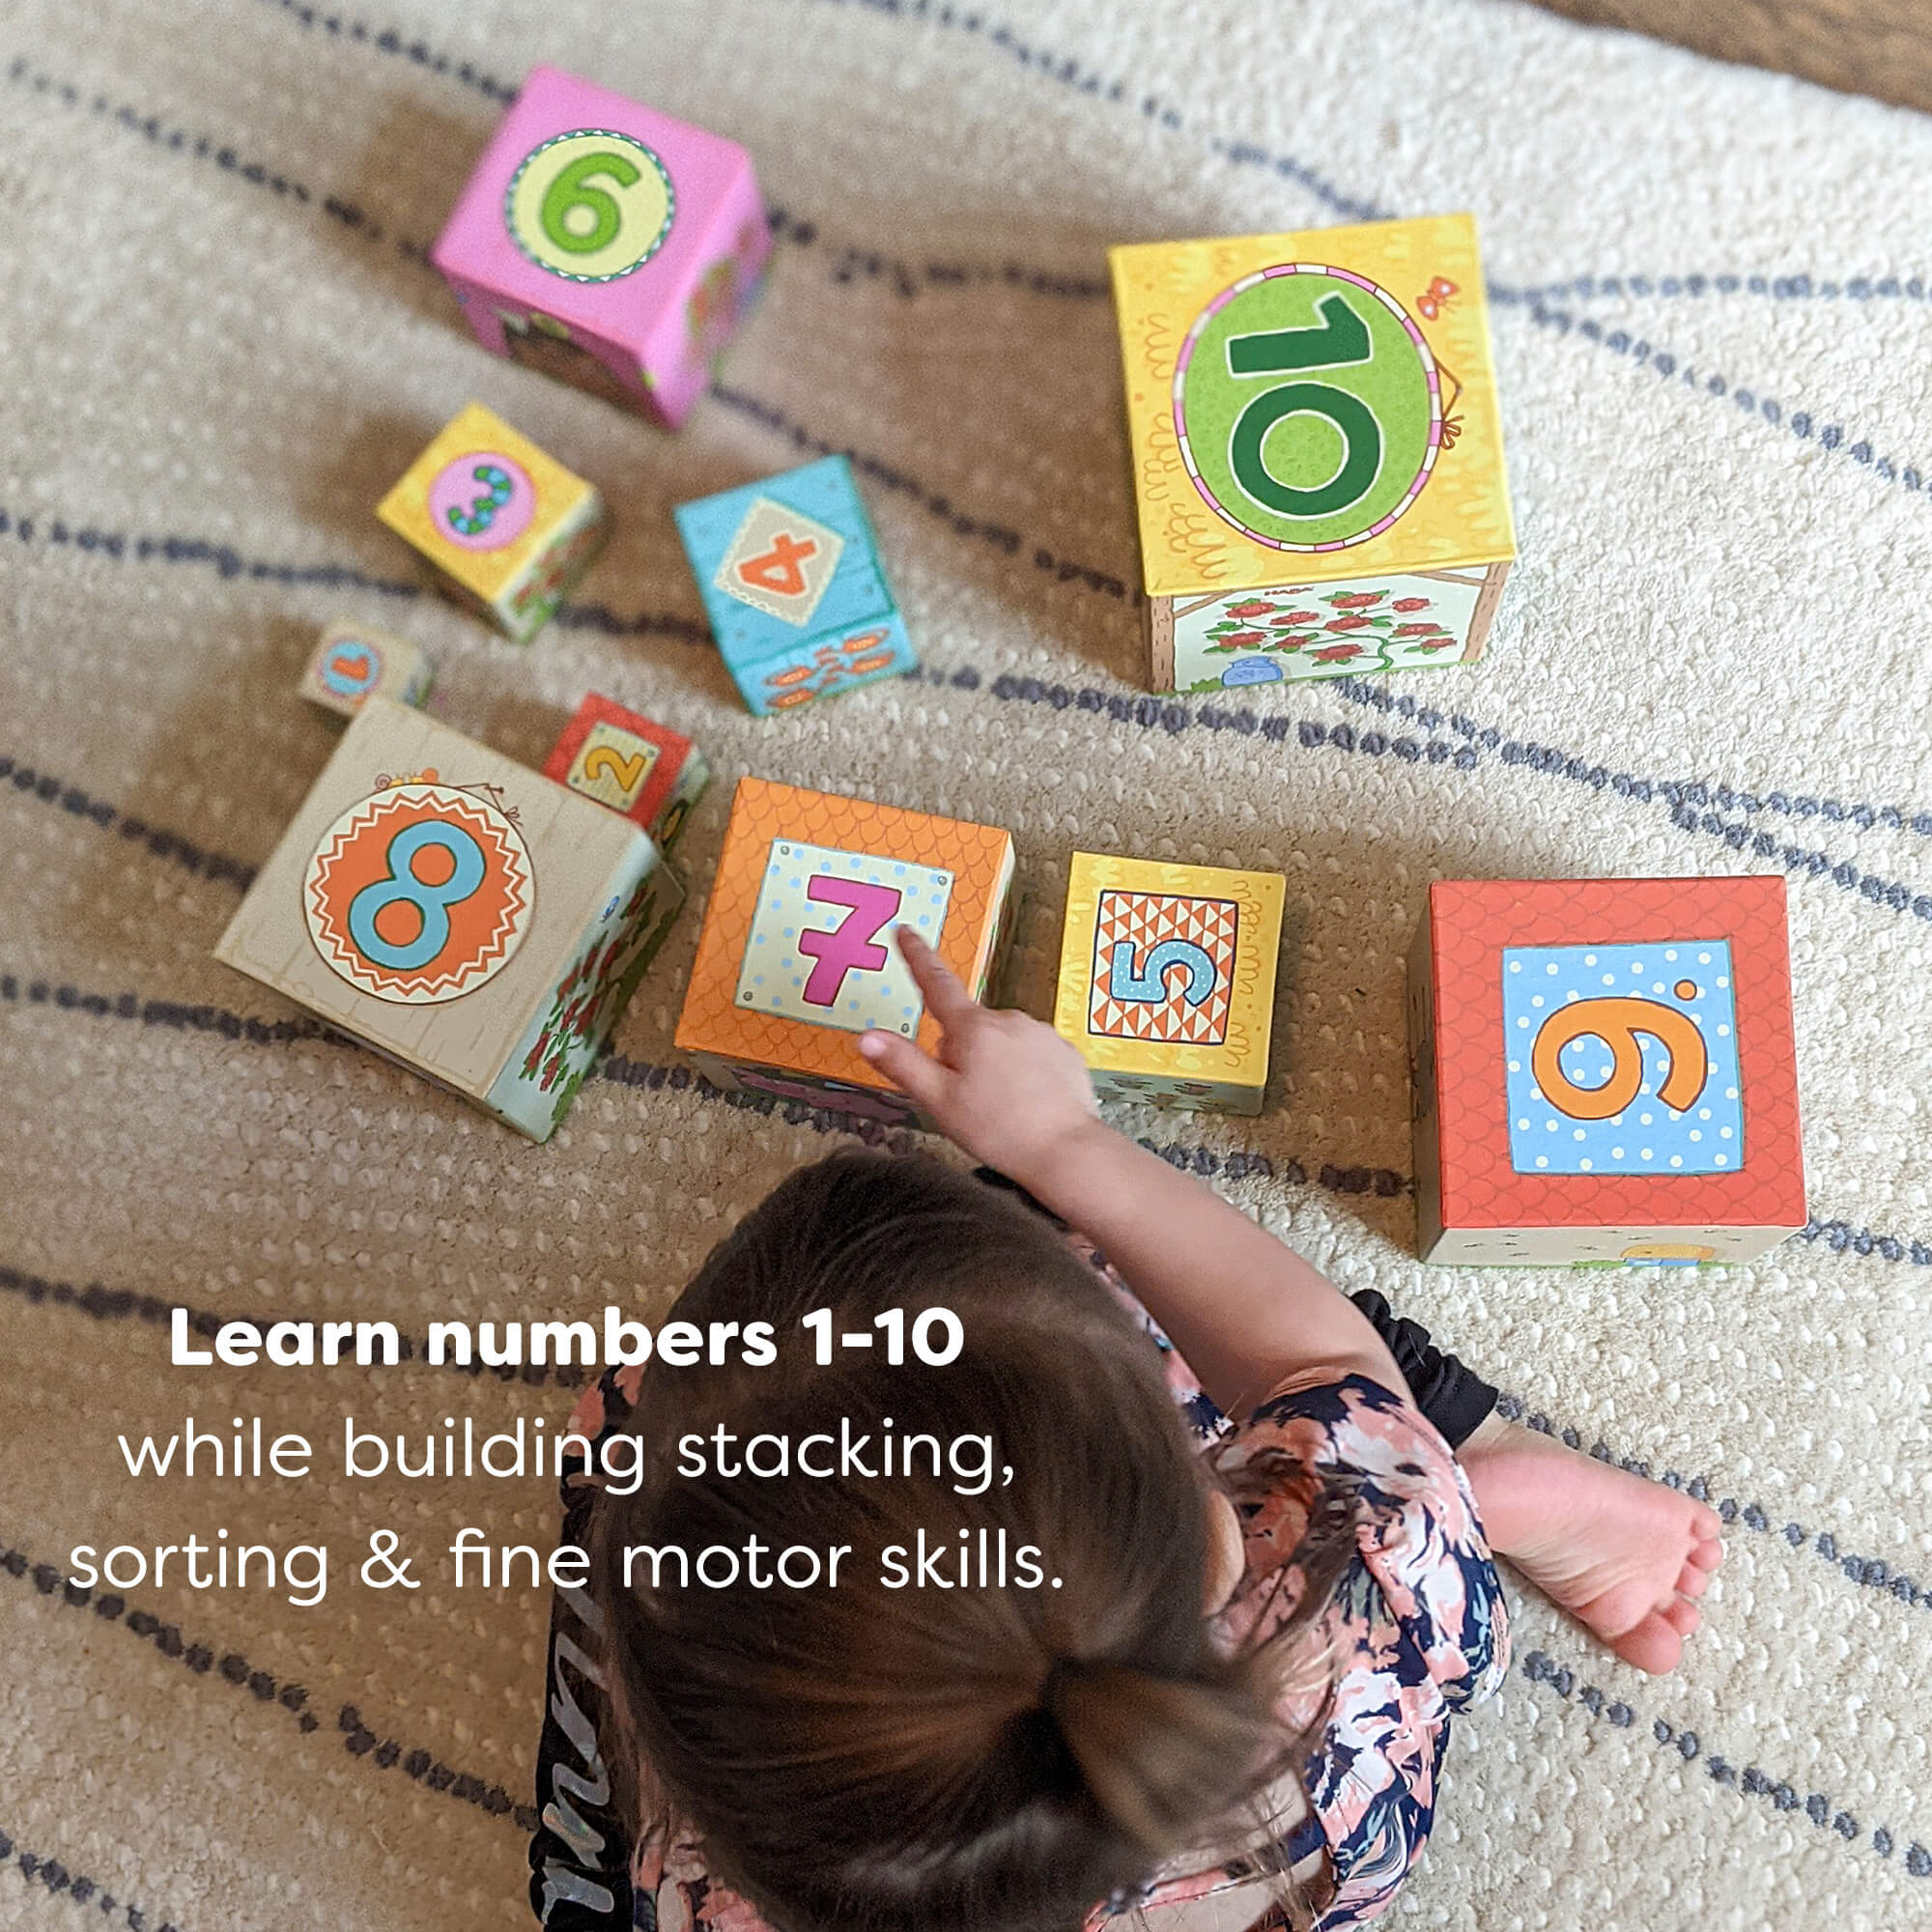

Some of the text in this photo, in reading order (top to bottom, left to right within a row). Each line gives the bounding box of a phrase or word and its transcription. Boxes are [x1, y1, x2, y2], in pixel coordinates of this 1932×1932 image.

[539, 151, 642, 256] 6
[1225, 290, 1385, 522] 10
[446, 464, 513, 536] 3
[737, 532, 818, 598] 4
[330, 654, 370, 682] 1
[583, 744, 647, 793] 2
[346, 818, 488, 971] 8
[797, 873, 903, 1008] 7
[1108, 937, 1218, 1008] 5
